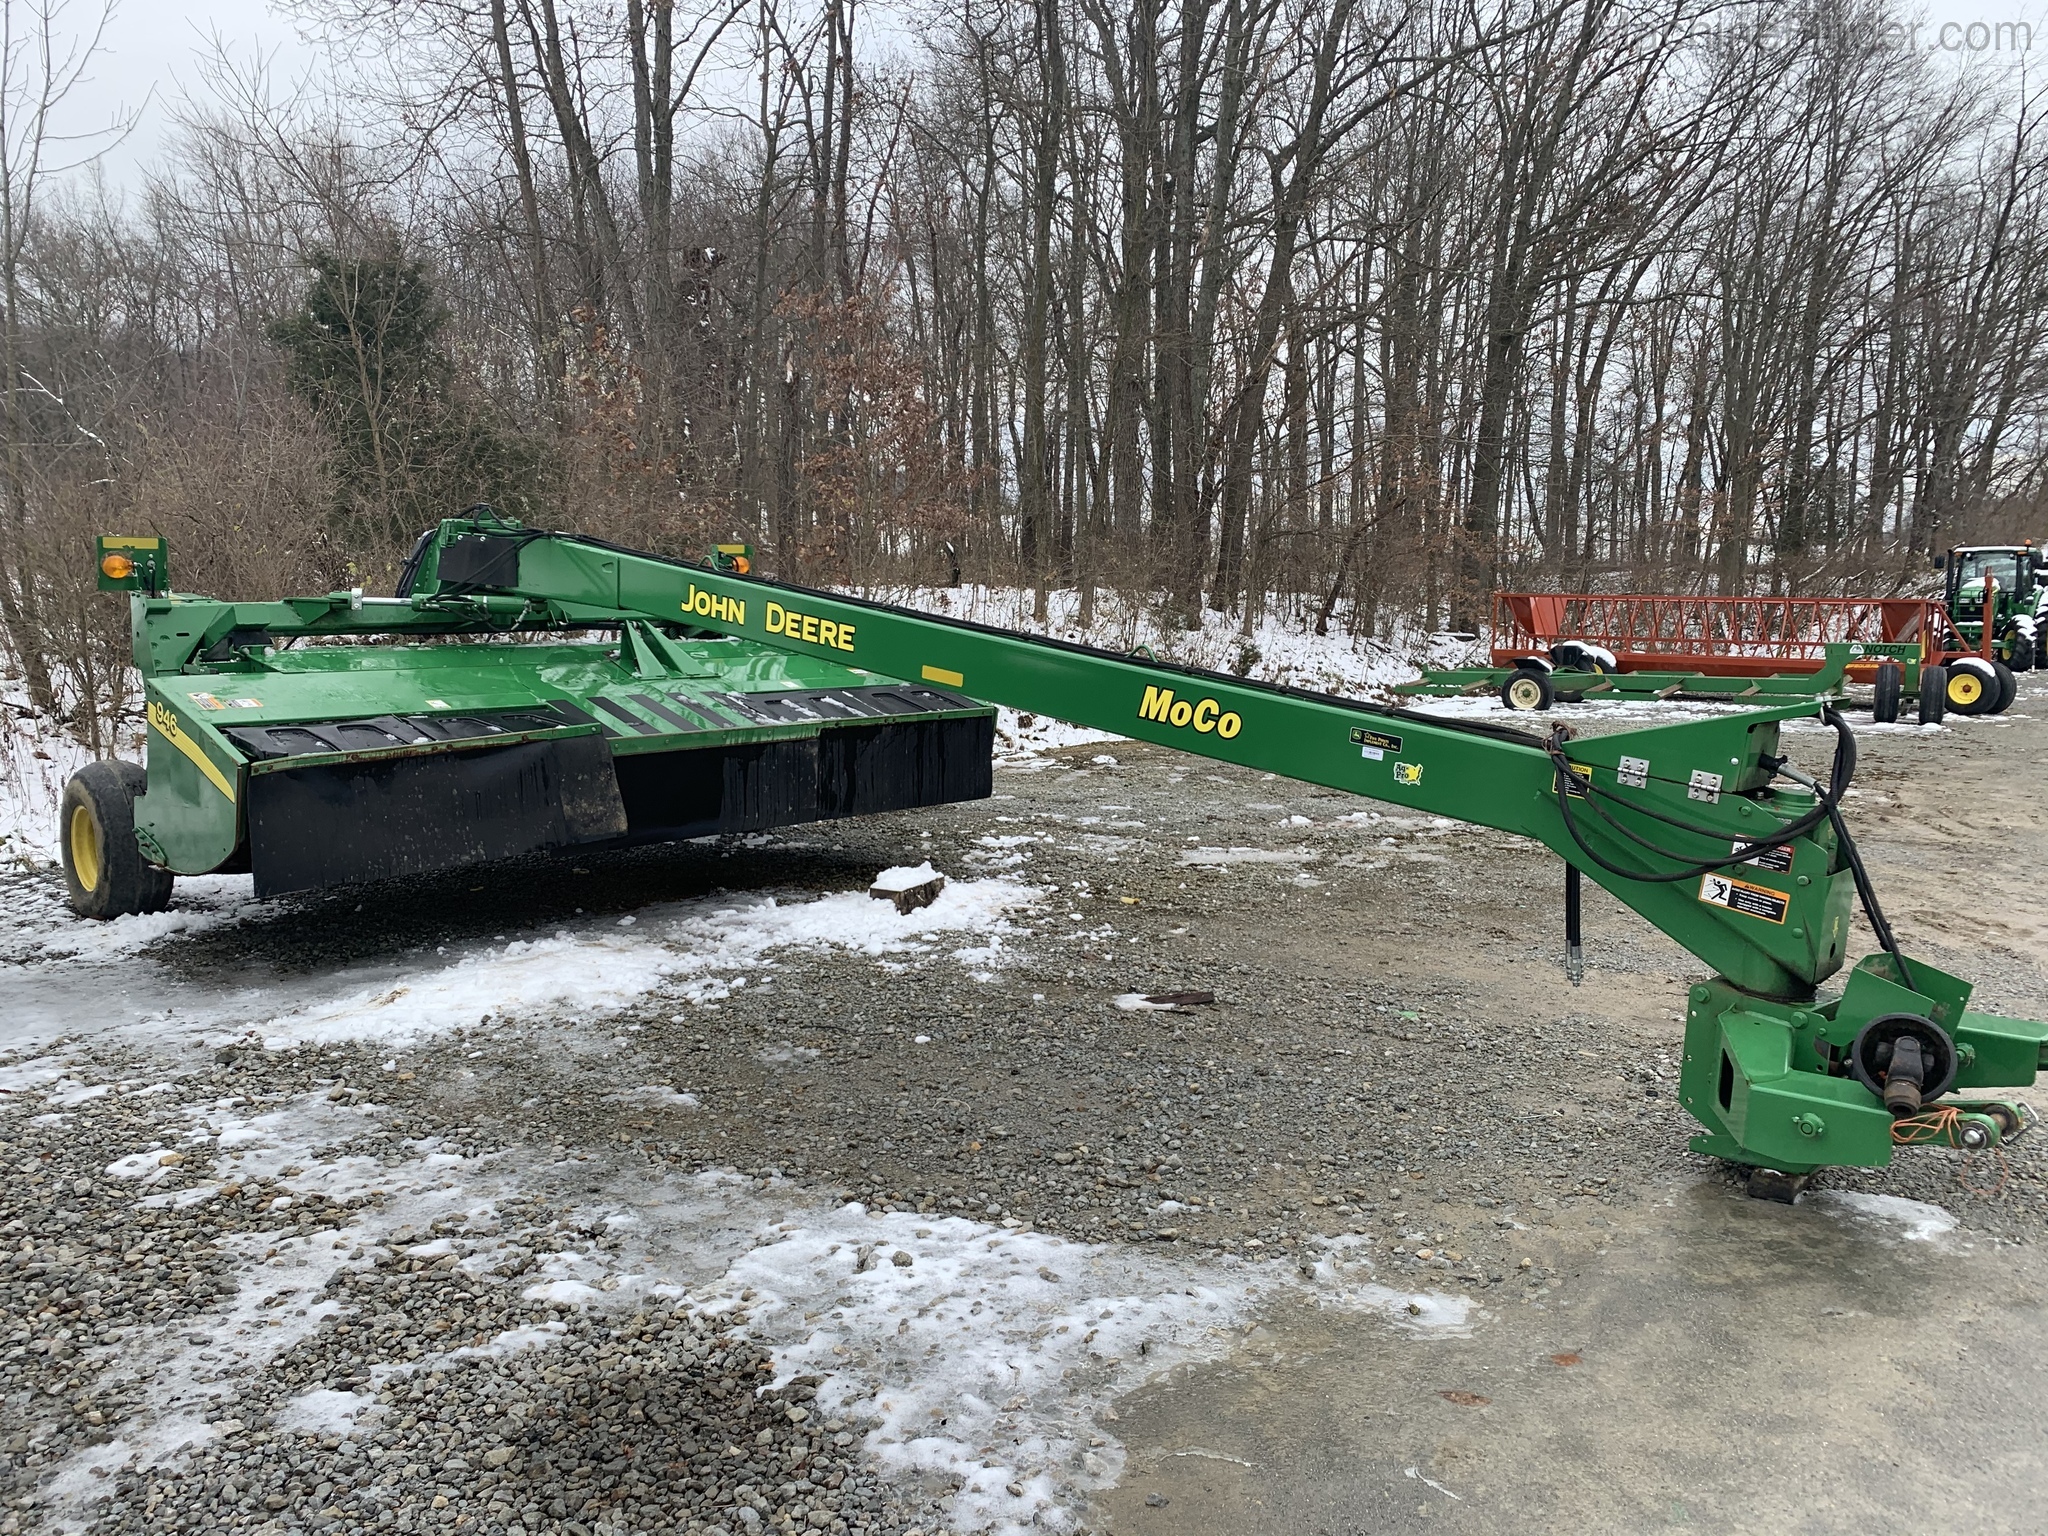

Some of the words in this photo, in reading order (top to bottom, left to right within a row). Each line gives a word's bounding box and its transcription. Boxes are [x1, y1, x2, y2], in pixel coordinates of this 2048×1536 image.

[681, 584, 746, 626] JOHN
[765, 601, 857, 652] DEERE
[1864, 645, 1907, 654] NOTCH
[155, 701, 178, 737] 946
[1137, 684, 1243, 740] MoCo
[1749, 884, 1776, 896] WARNING
